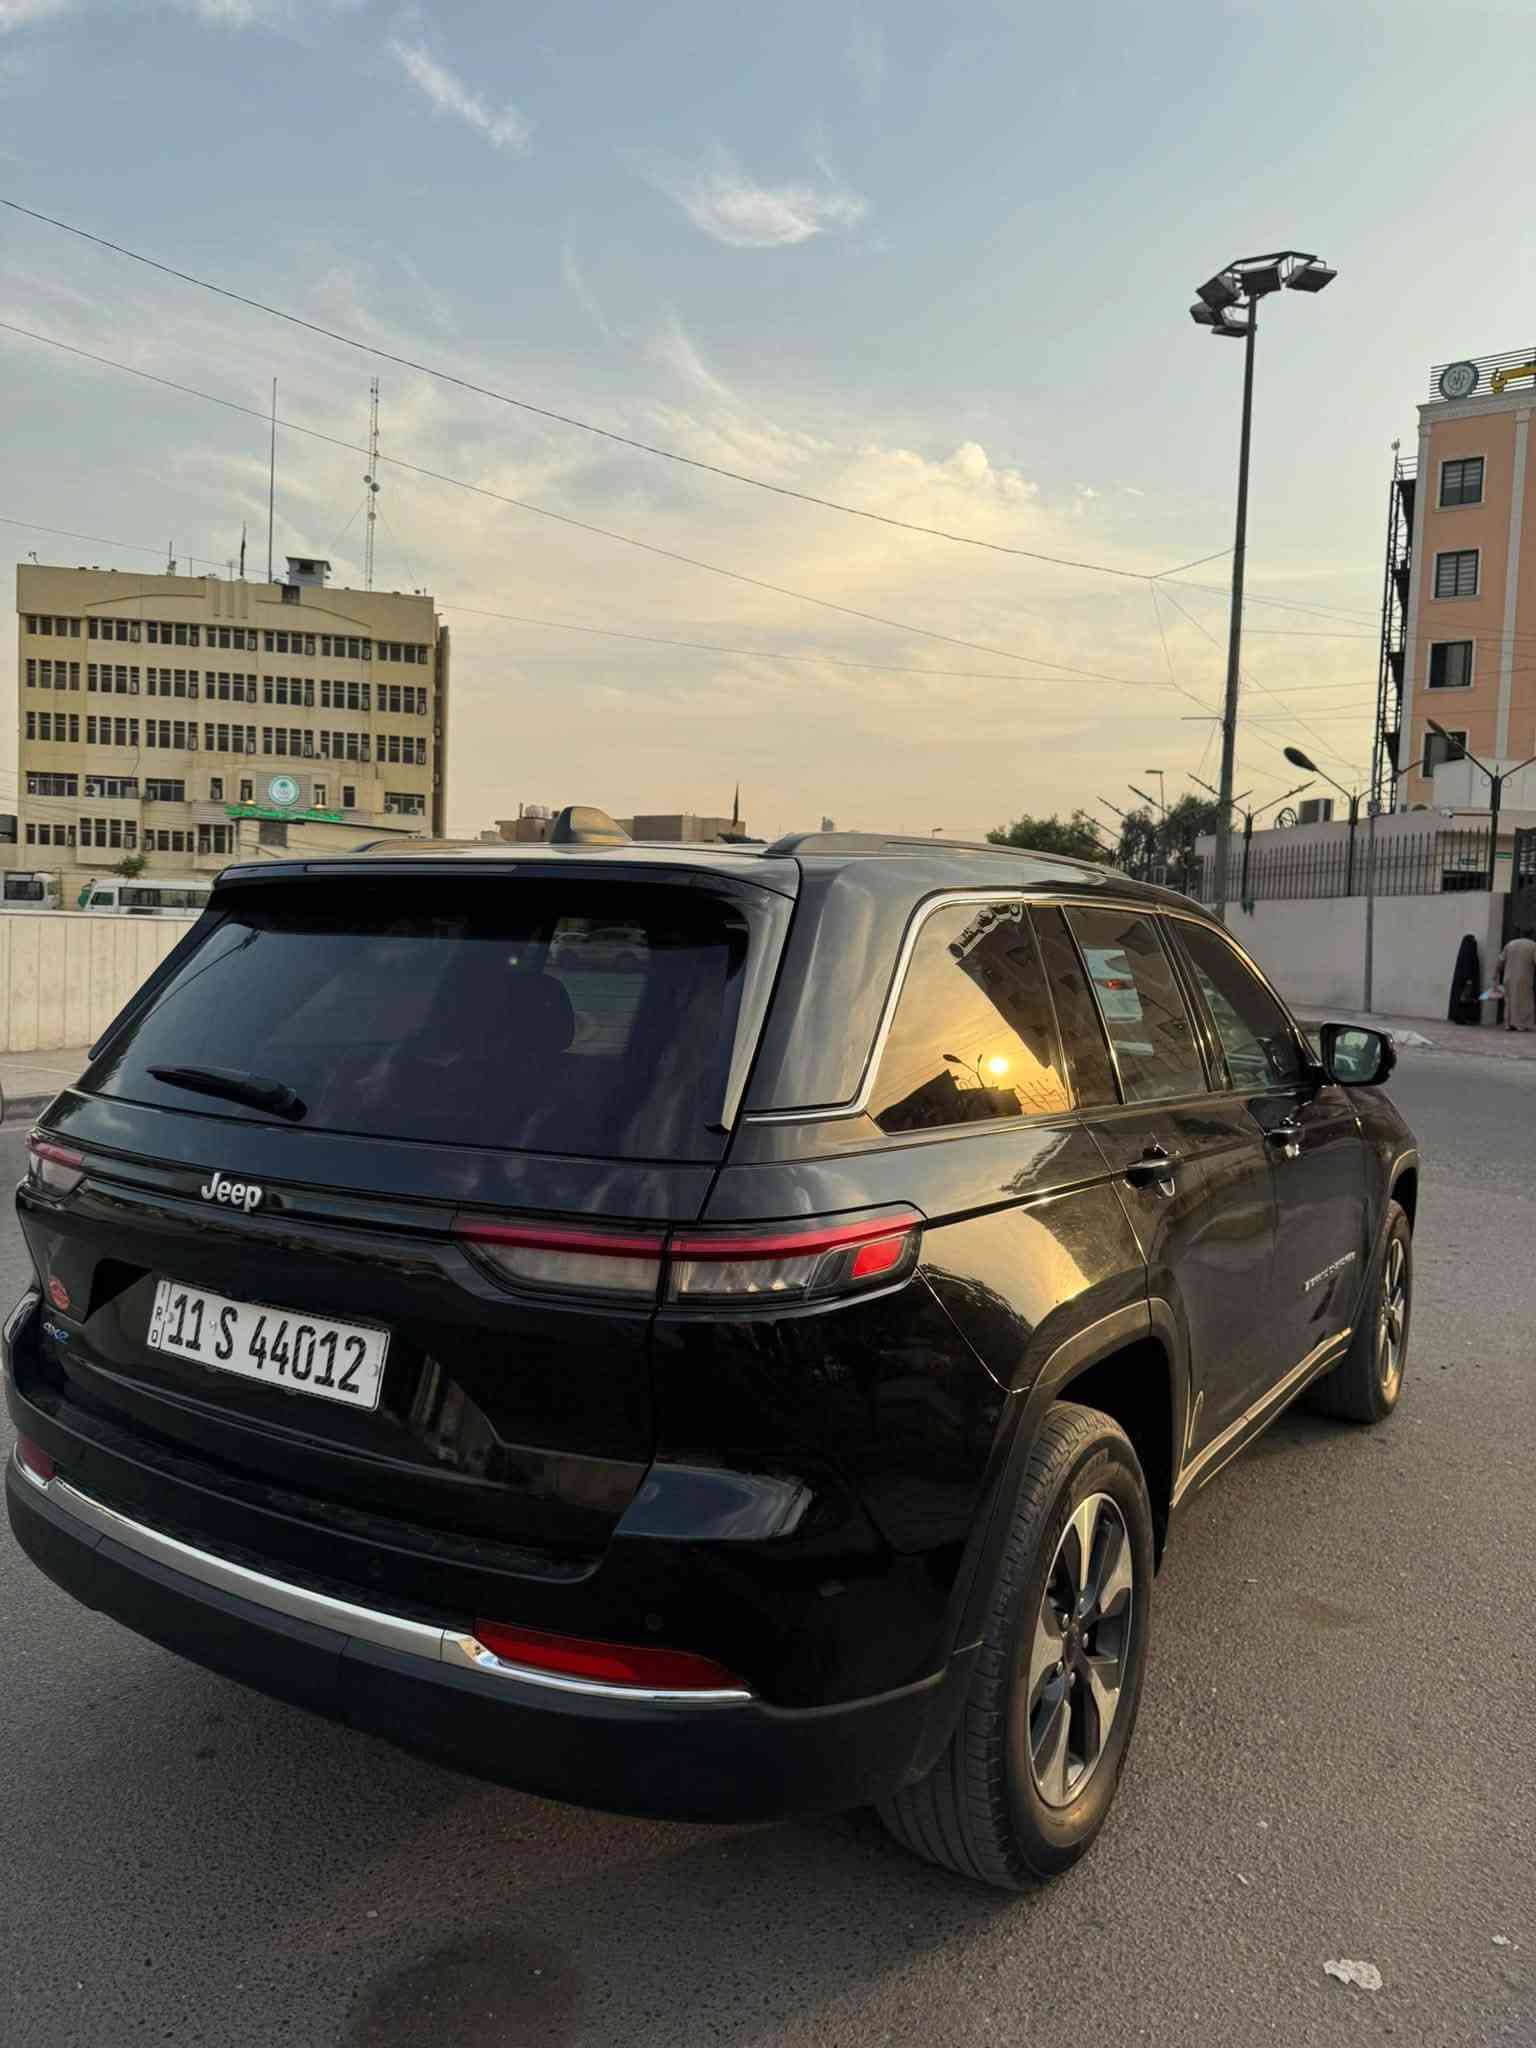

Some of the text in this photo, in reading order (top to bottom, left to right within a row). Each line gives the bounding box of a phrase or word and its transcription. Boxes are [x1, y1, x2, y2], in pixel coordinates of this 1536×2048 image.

[201, 1172, 262, 1212] Jeep
[168, 1294, 367, 1394] 11 S 44012
